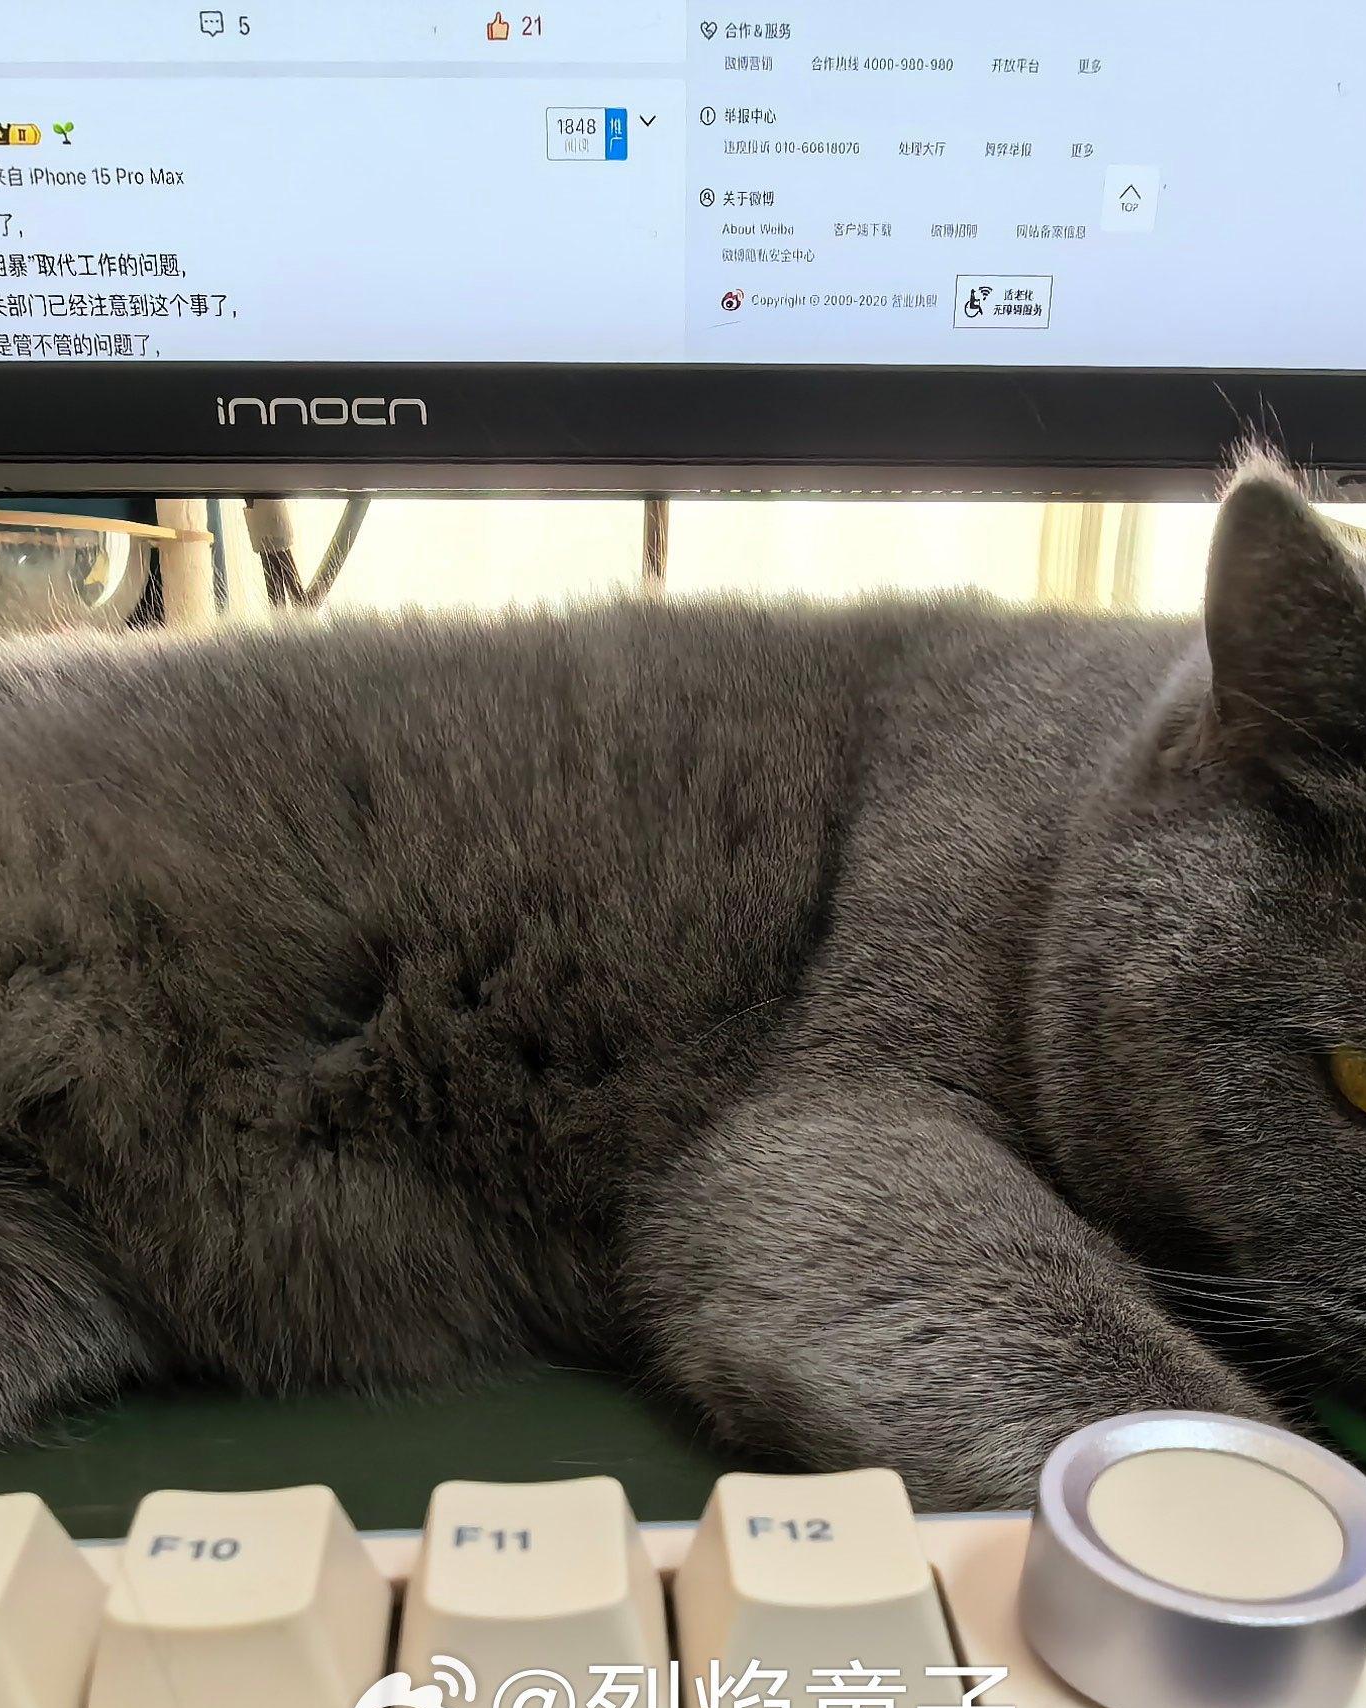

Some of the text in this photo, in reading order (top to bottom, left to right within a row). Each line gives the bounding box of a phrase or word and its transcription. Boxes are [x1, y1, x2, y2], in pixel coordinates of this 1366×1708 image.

[239, 16, 250, 36] 5
[522, 15, 541, 36] 21
[557, 117, 596, 135] 1848
[92, 167, 111, 185] 15
[116, 167, 144, 185] Pro
[148, 167, 186, 188] Max
[453, 1525, 531, 1552] F11
[747, 1516, 834, 1544] F12
[148, 1535, 240, 1564] F10
